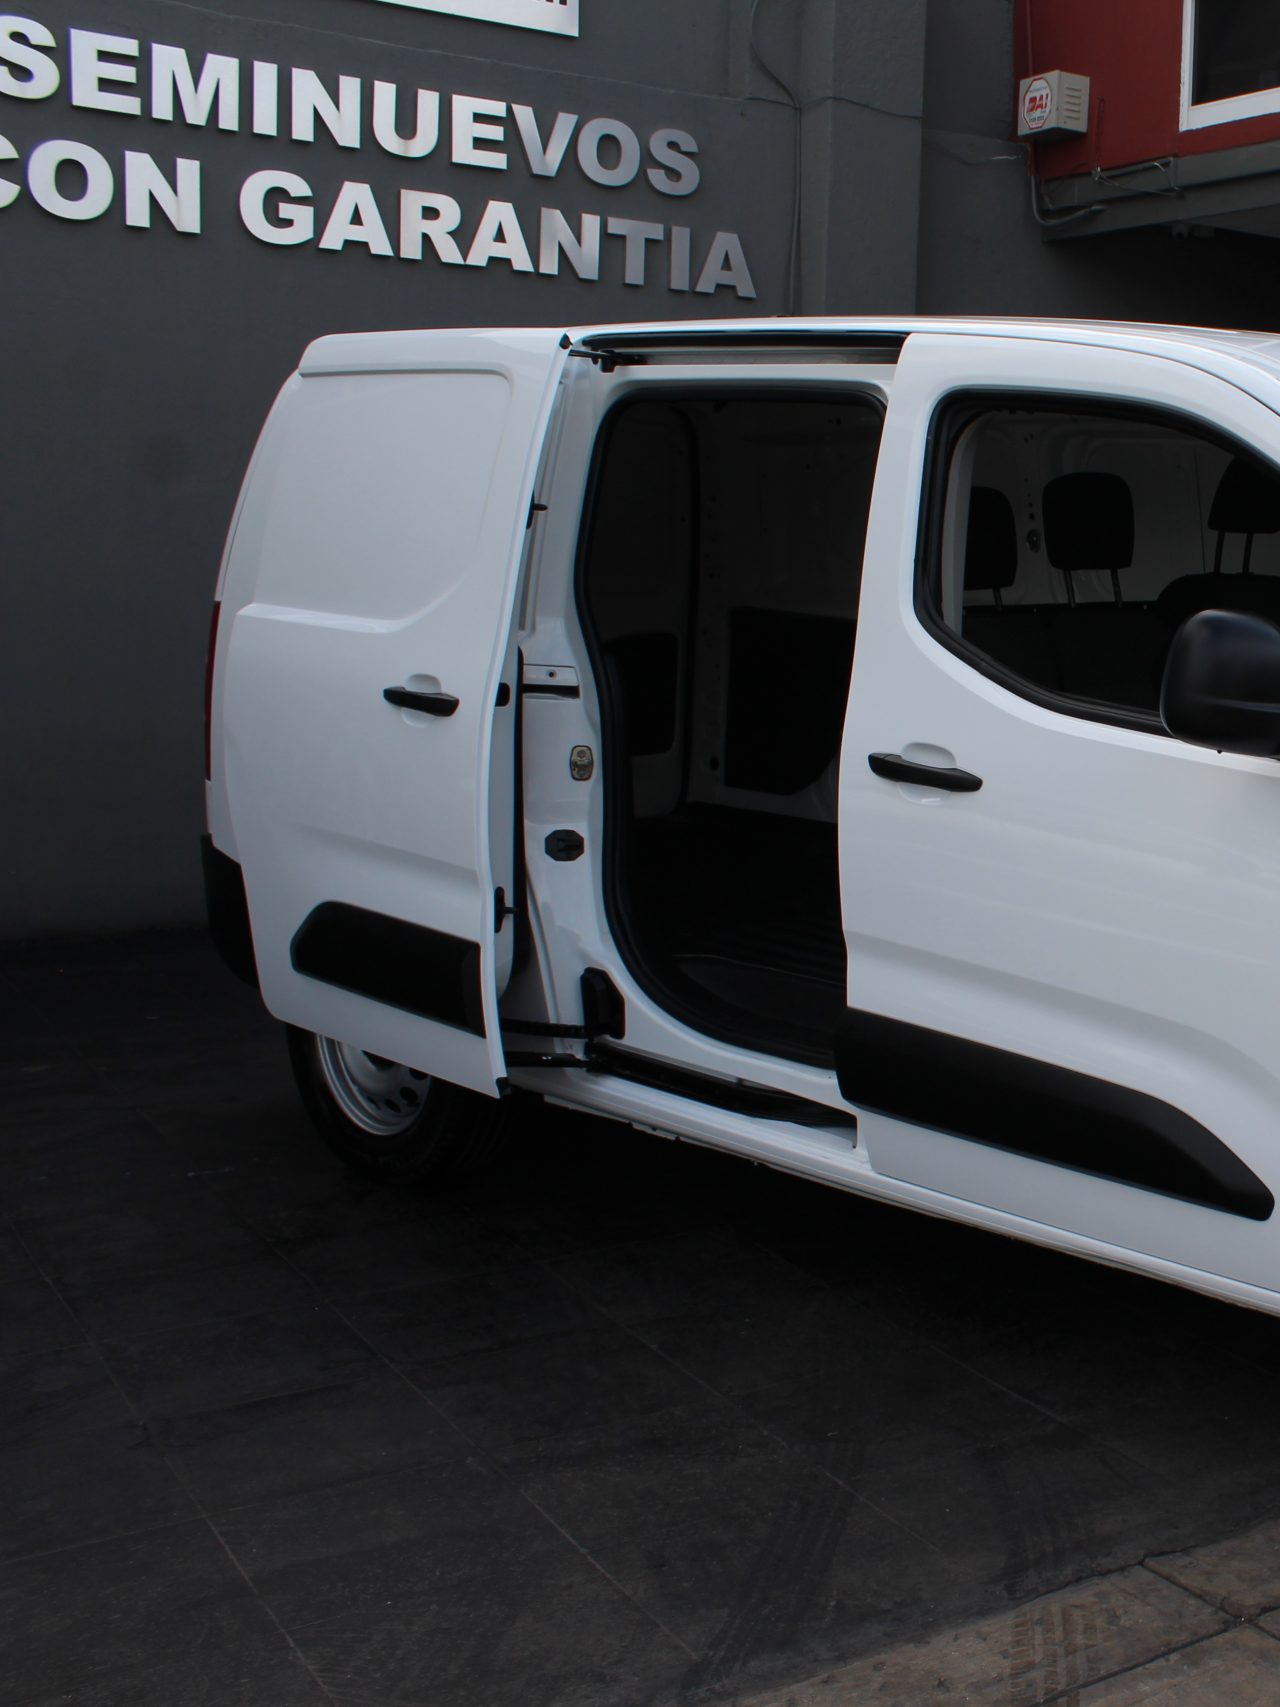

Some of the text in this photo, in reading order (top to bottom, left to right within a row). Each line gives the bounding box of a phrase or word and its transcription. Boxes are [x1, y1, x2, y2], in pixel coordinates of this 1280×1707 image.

[0, 14, 701, 197] SEMINUEVOS
[0, 131, 757, 299] ON GARANTIA
